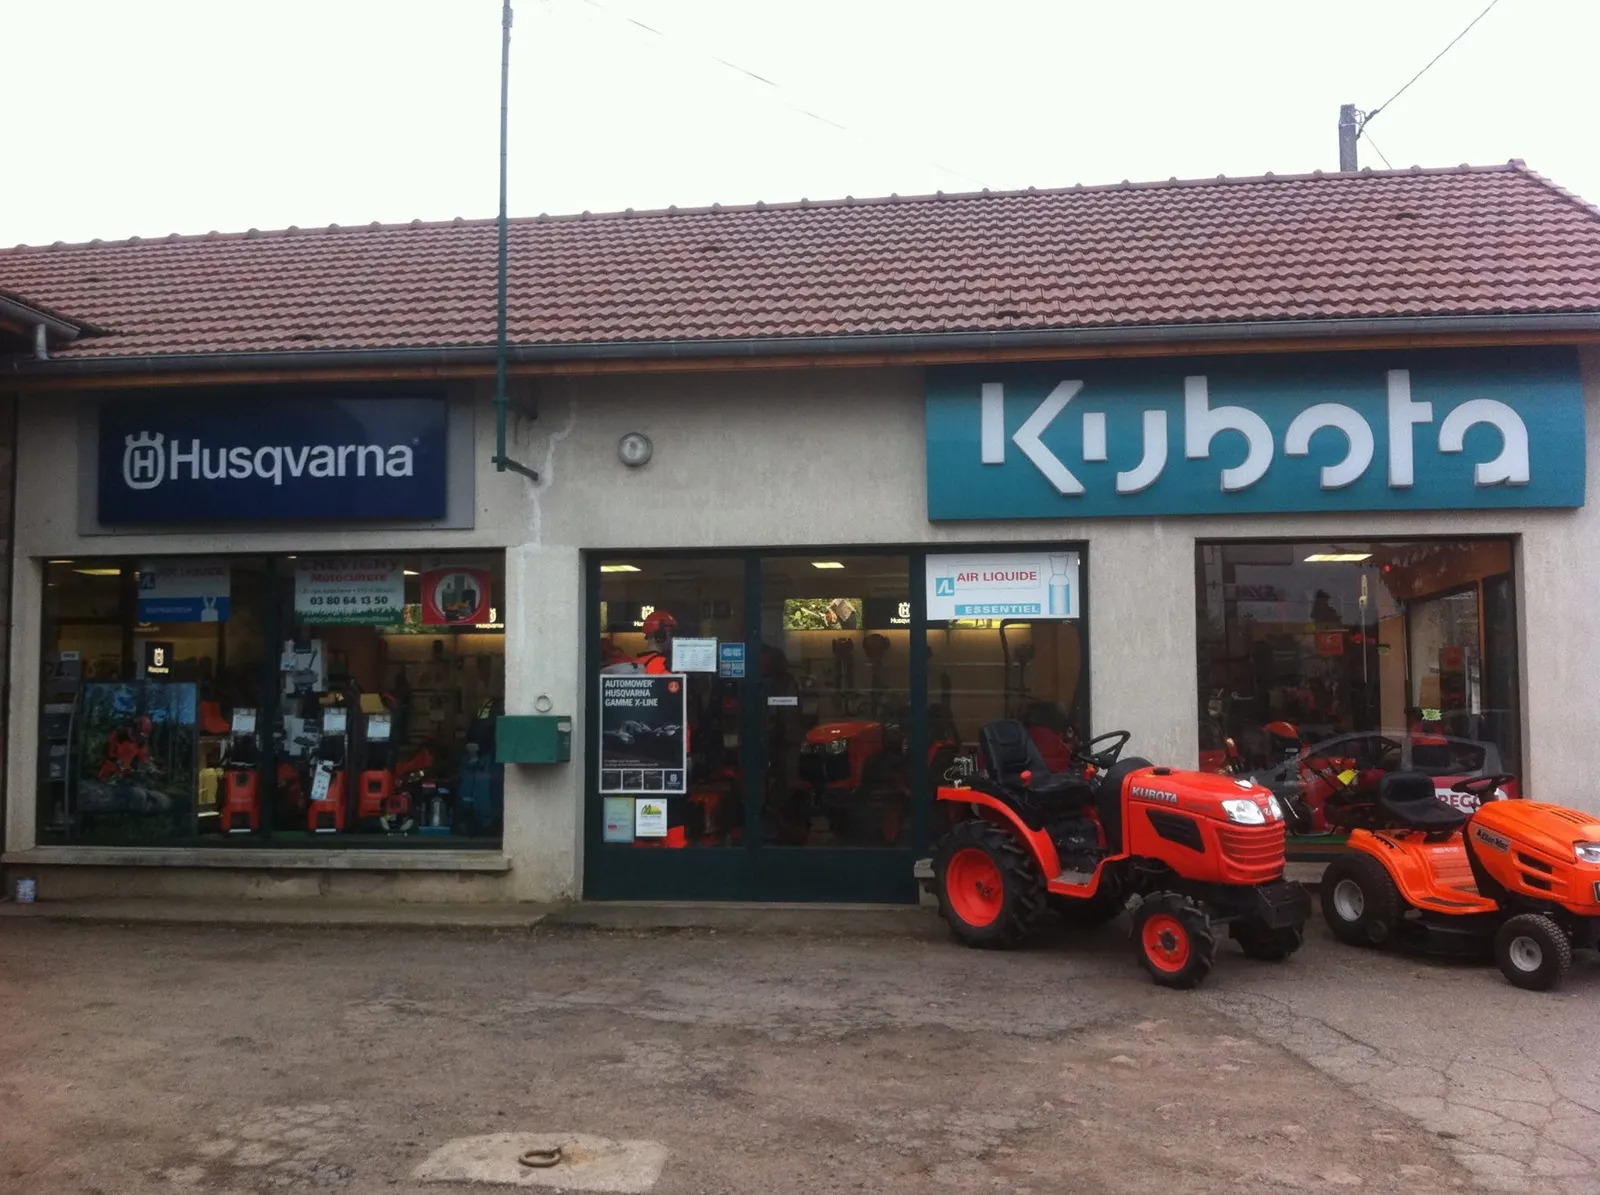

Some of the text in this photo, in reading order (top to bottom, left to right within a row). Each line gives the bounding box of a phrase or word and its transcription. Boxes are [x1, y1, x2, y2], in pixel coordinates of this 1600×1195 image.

[981, 369, 1530, 496] Kubota
[169, 438, 414, 486] Husqvarna
[956, 571, 1038, 582] AIR LIQUIDE
[310, 595, 388, 605] 03 80 64 13 50
[964, 604, 1040, 614] ESSENTIEL
[604, 679, 653, 688] AUTOMOWER
[604, 689, 651, 697] HUSQVARNA
[604, 698, 659, 707] GAMME X-LINE
[1132, 786, 1178, 804] KUBOTA
